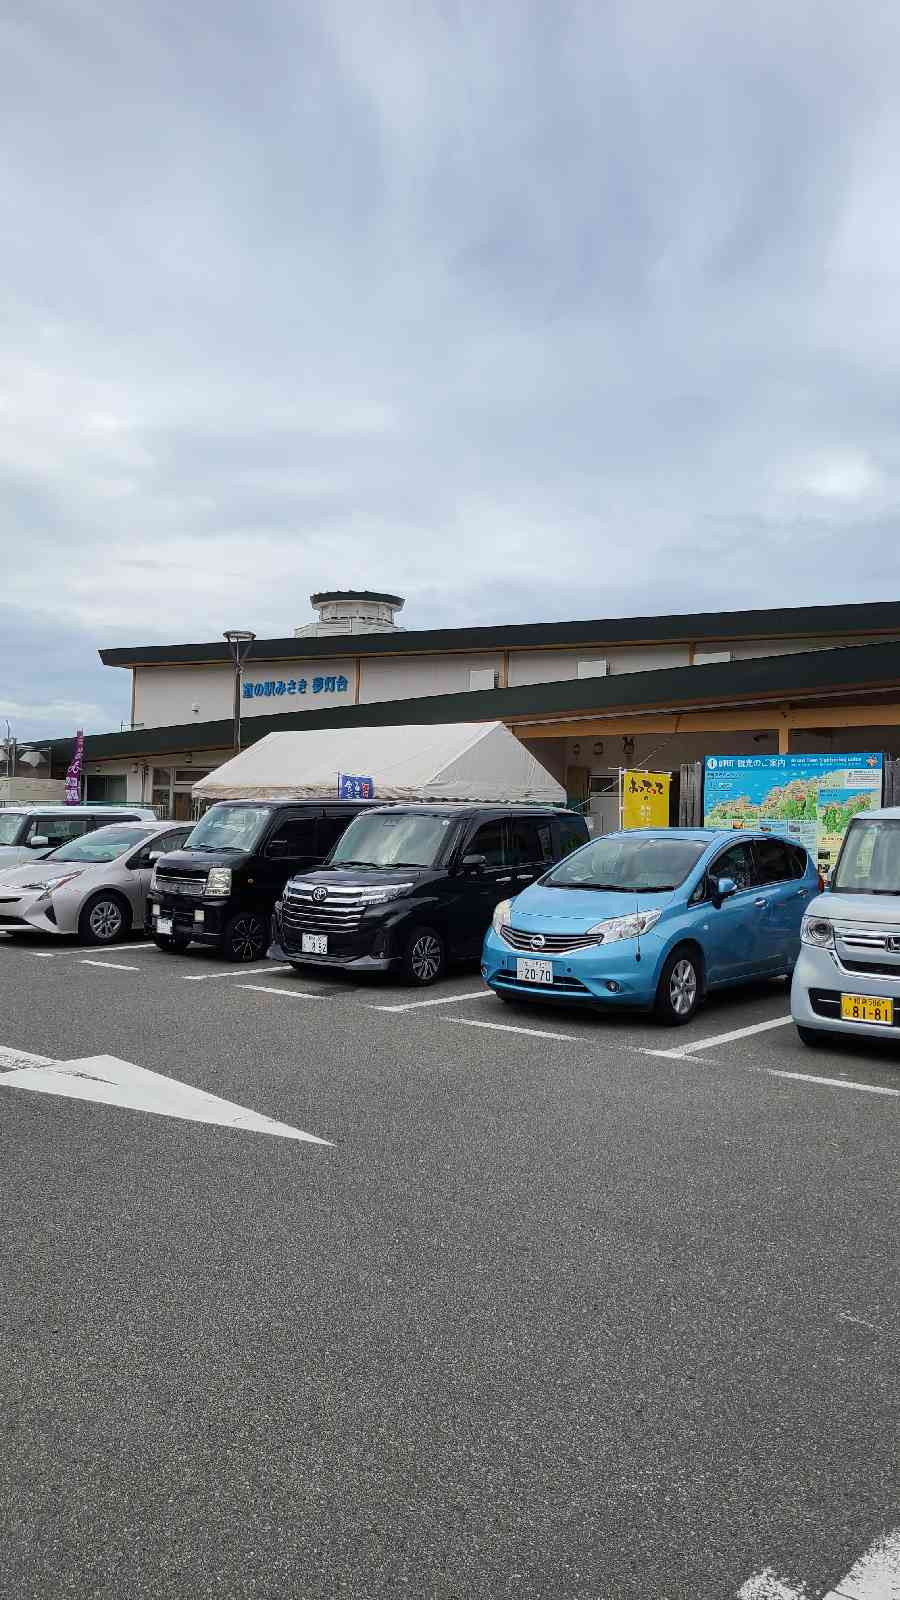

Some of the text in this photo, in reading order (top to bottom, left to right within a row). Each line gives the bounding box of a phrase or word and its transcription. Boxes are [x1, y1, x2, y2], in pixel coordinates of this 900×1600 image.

[242, 675, 348, 699] 道の駅みさき 夢灯台
[524, 968, 551, 981] 20-70
[852, 1006, 888, 1021] 81-81
